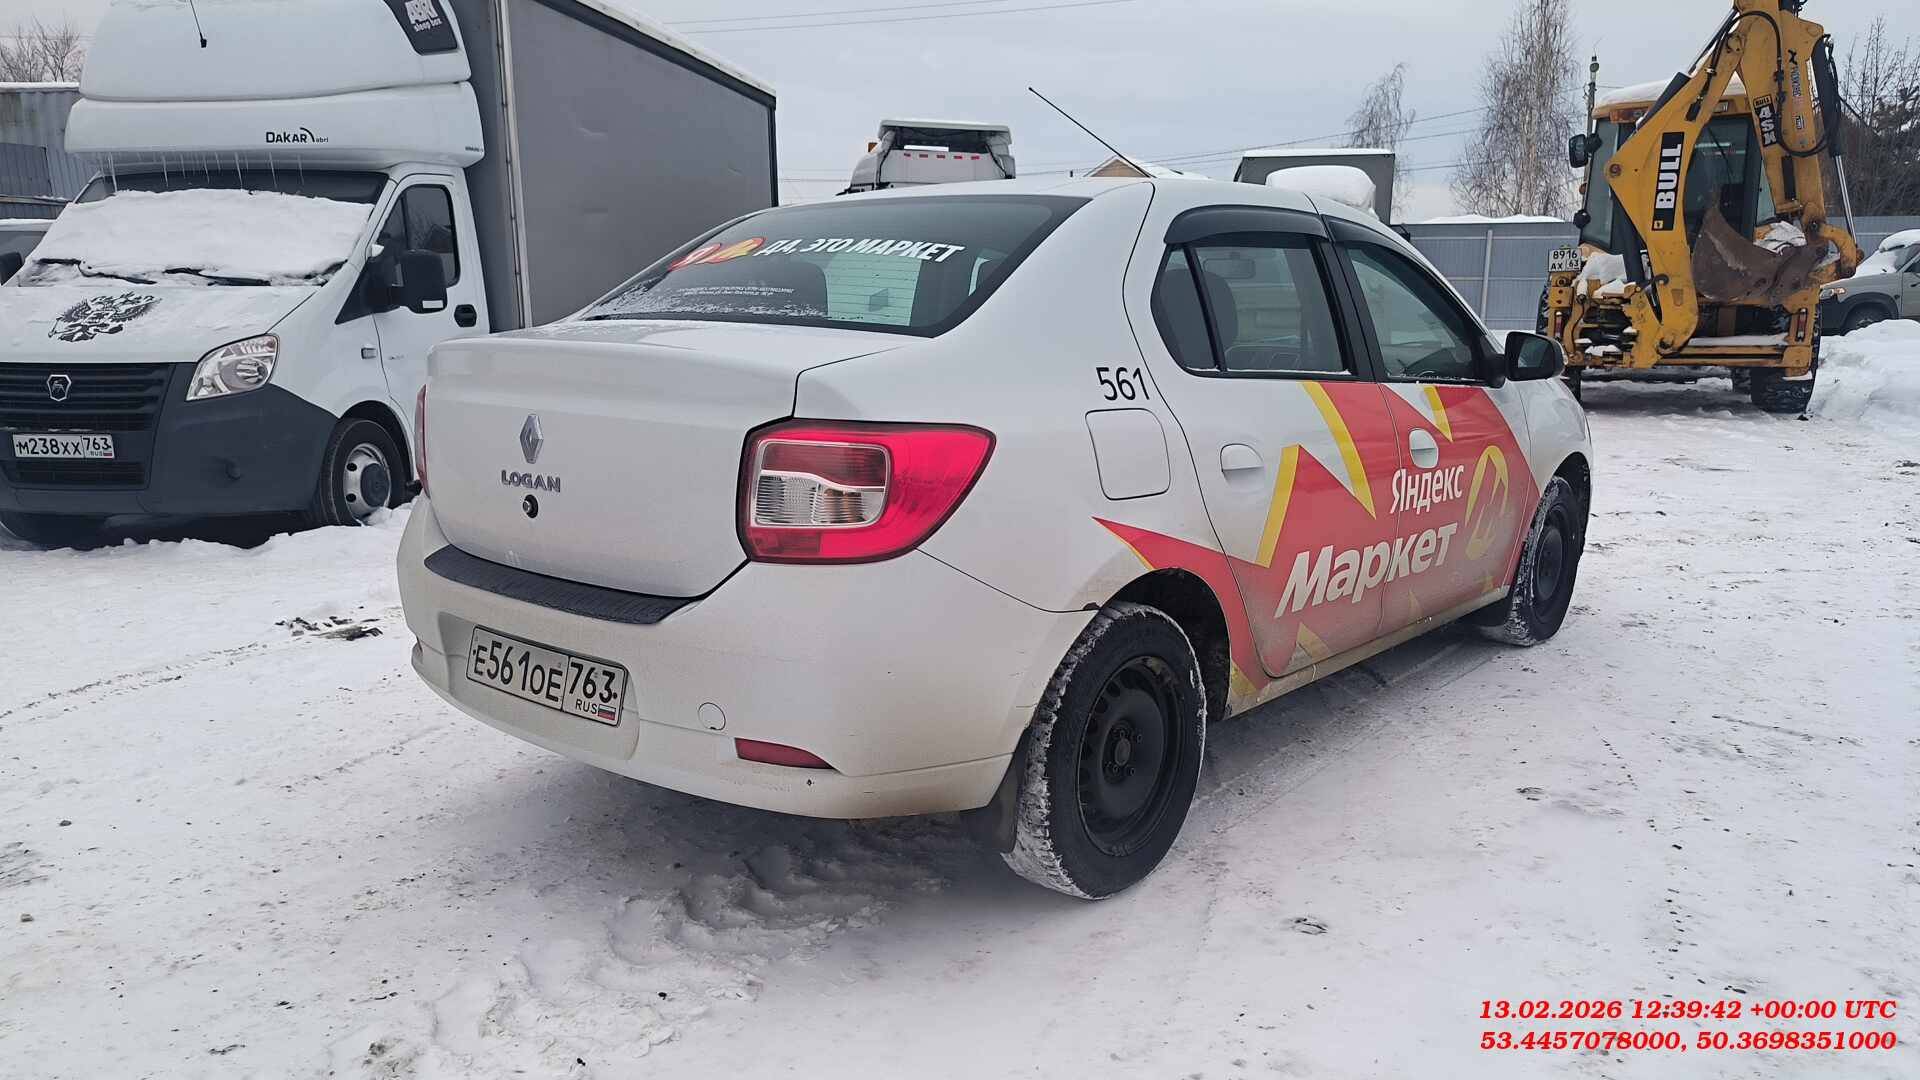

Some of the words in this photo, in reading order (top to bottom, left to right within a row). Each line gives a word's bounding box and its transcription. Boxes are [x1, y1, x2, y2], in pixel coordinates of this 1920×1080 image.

[1655, 144, 1682, 209] BULL
[753, 239, 802, 257] ДА,
[800, 239, 853, 253] ЭТО
[845, 239, 965, 263] МАРКЕТ
[1553, 250, 1578, 260] 8916
[1096, 366, 1150, 401] 561
[17, 438, 82, 455] М238ХХ
[83, 437, 109, 451] 763
[501, 469, 561, 493] LOGAN
[1389, 464, 1465, 515] Яндекс
[1274, 522, 1458, 619] Маркет
[474, 640, 563, 703] Е561ОЕ
[568, 661, 616, 704] 763
[575, 698, 599, 715] RUS
